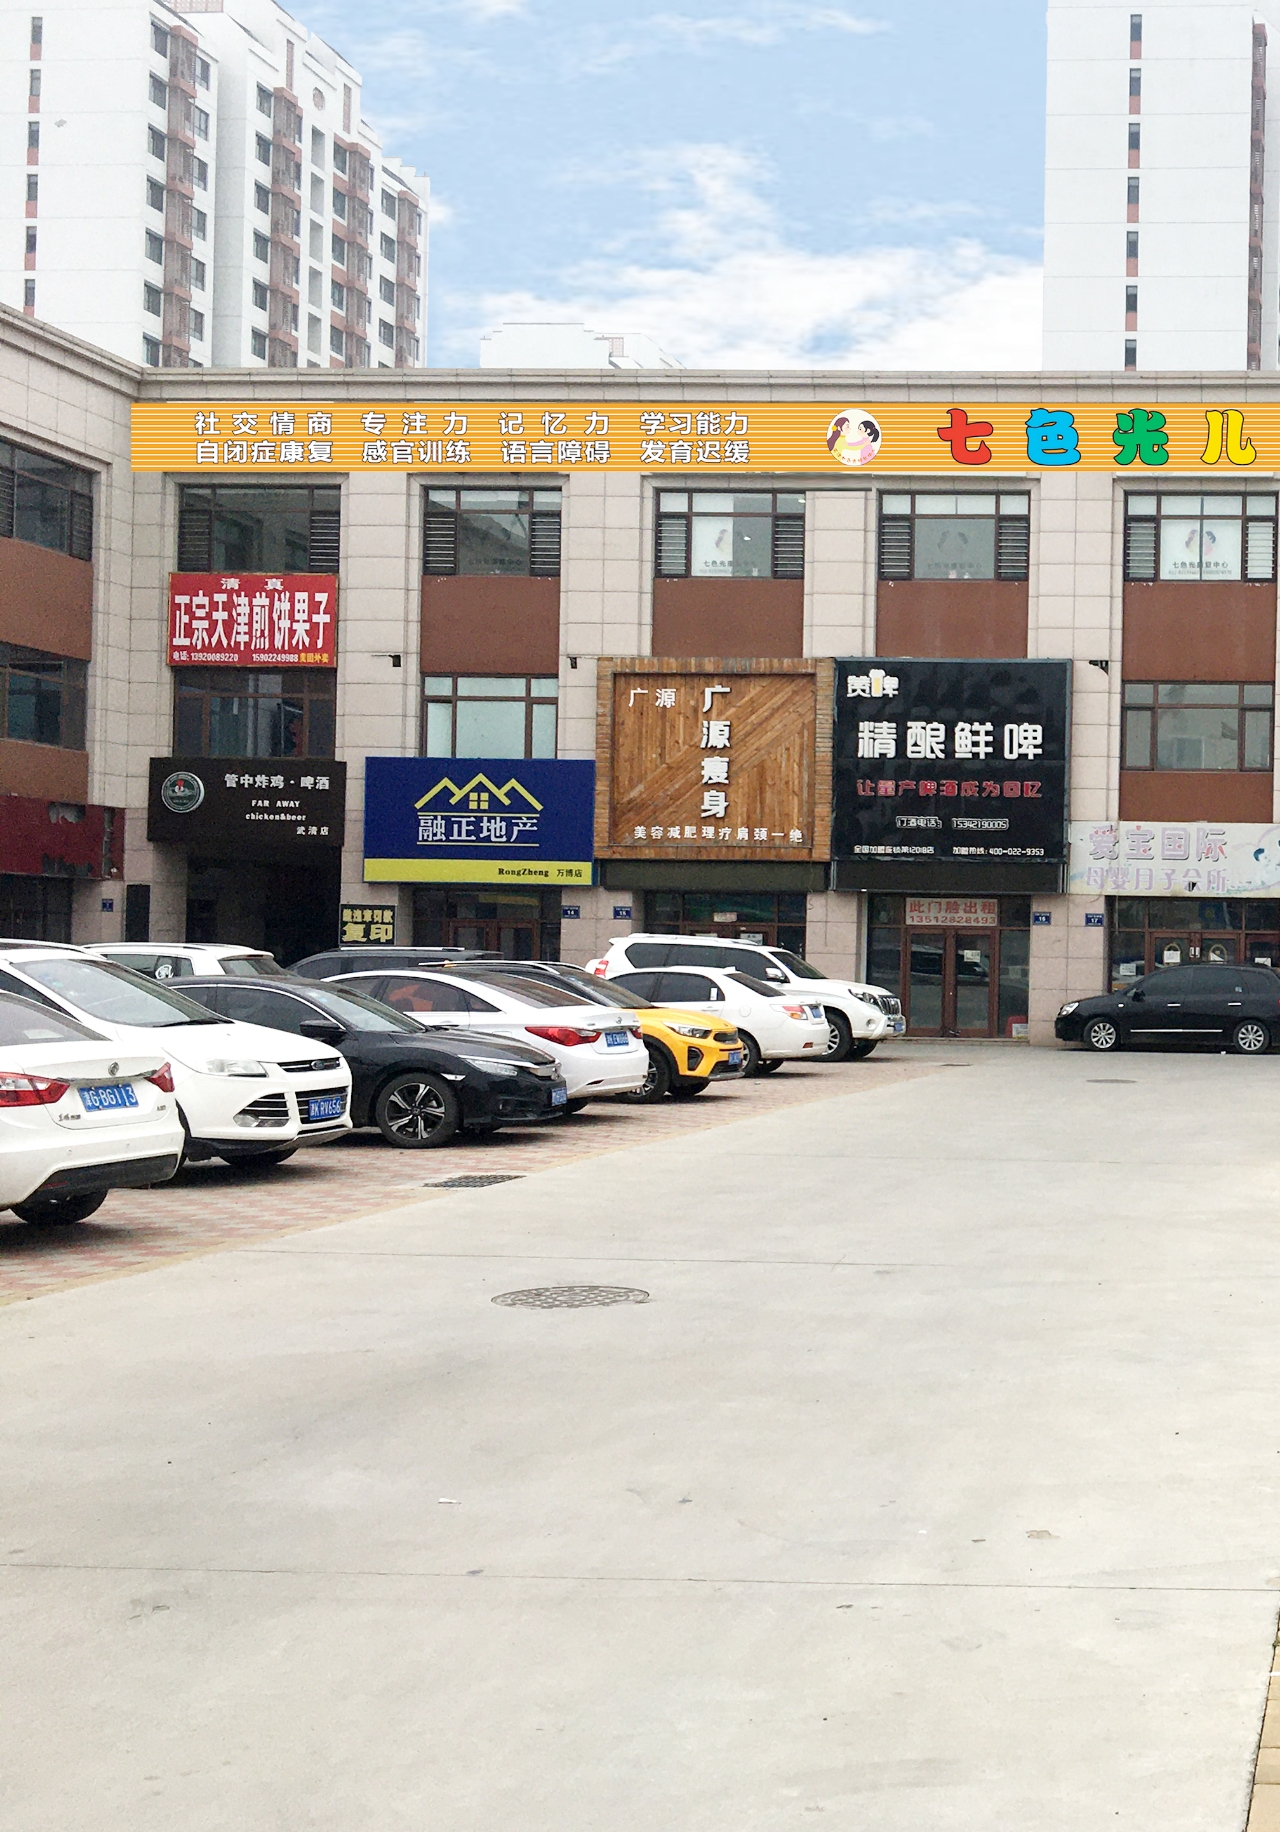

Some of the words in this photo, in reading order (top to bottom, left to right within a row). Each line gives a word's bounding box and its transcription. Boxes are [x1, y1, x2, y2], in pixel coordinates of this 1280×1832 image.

[195, 411, 333, 436] 社交情商
[361, 411, 468, 436] 专注力
[499, 411, 610, 436] 记忆力
[640, 411, 750, 436] 学习能力
[196, 440, 333, 464] 自闭症康复
[362, 440, 471, 464] 感官训练
[501, 440, 610, 464] 语言障碍
[641, 440, 750, 464] 发育迟缓
[220, 578, 284, 590] 清真
[173, 590, 331, 650] 正宗天津煎饼果子
[629, 688, 676, 708] 广源
[857, 721, 1043, 760] 精酿鲜啤
[700, 685, 731, 818] 广源瘦身
[856, 779, 1042, 797] 让量产啤酒成为回忆
[276, 800, 301, 808] AWAY
[296, 826, 329, 836] 武清店
[418, 816, 538, 843] 融正地产
[634, 825, 803, 843] 美容减肥理疗肩颈一绝
[1089, 826, 1227, 861] 爱宝国际
[498, 868, 549, 878] RongZheng
[556, 869, 583, 878] 万博店
[1085, 867, 1228, 893] 母婴月子会所
[909, 901, 997, 914] 此门脸出租
[342, 923, 393, 943] 复印
